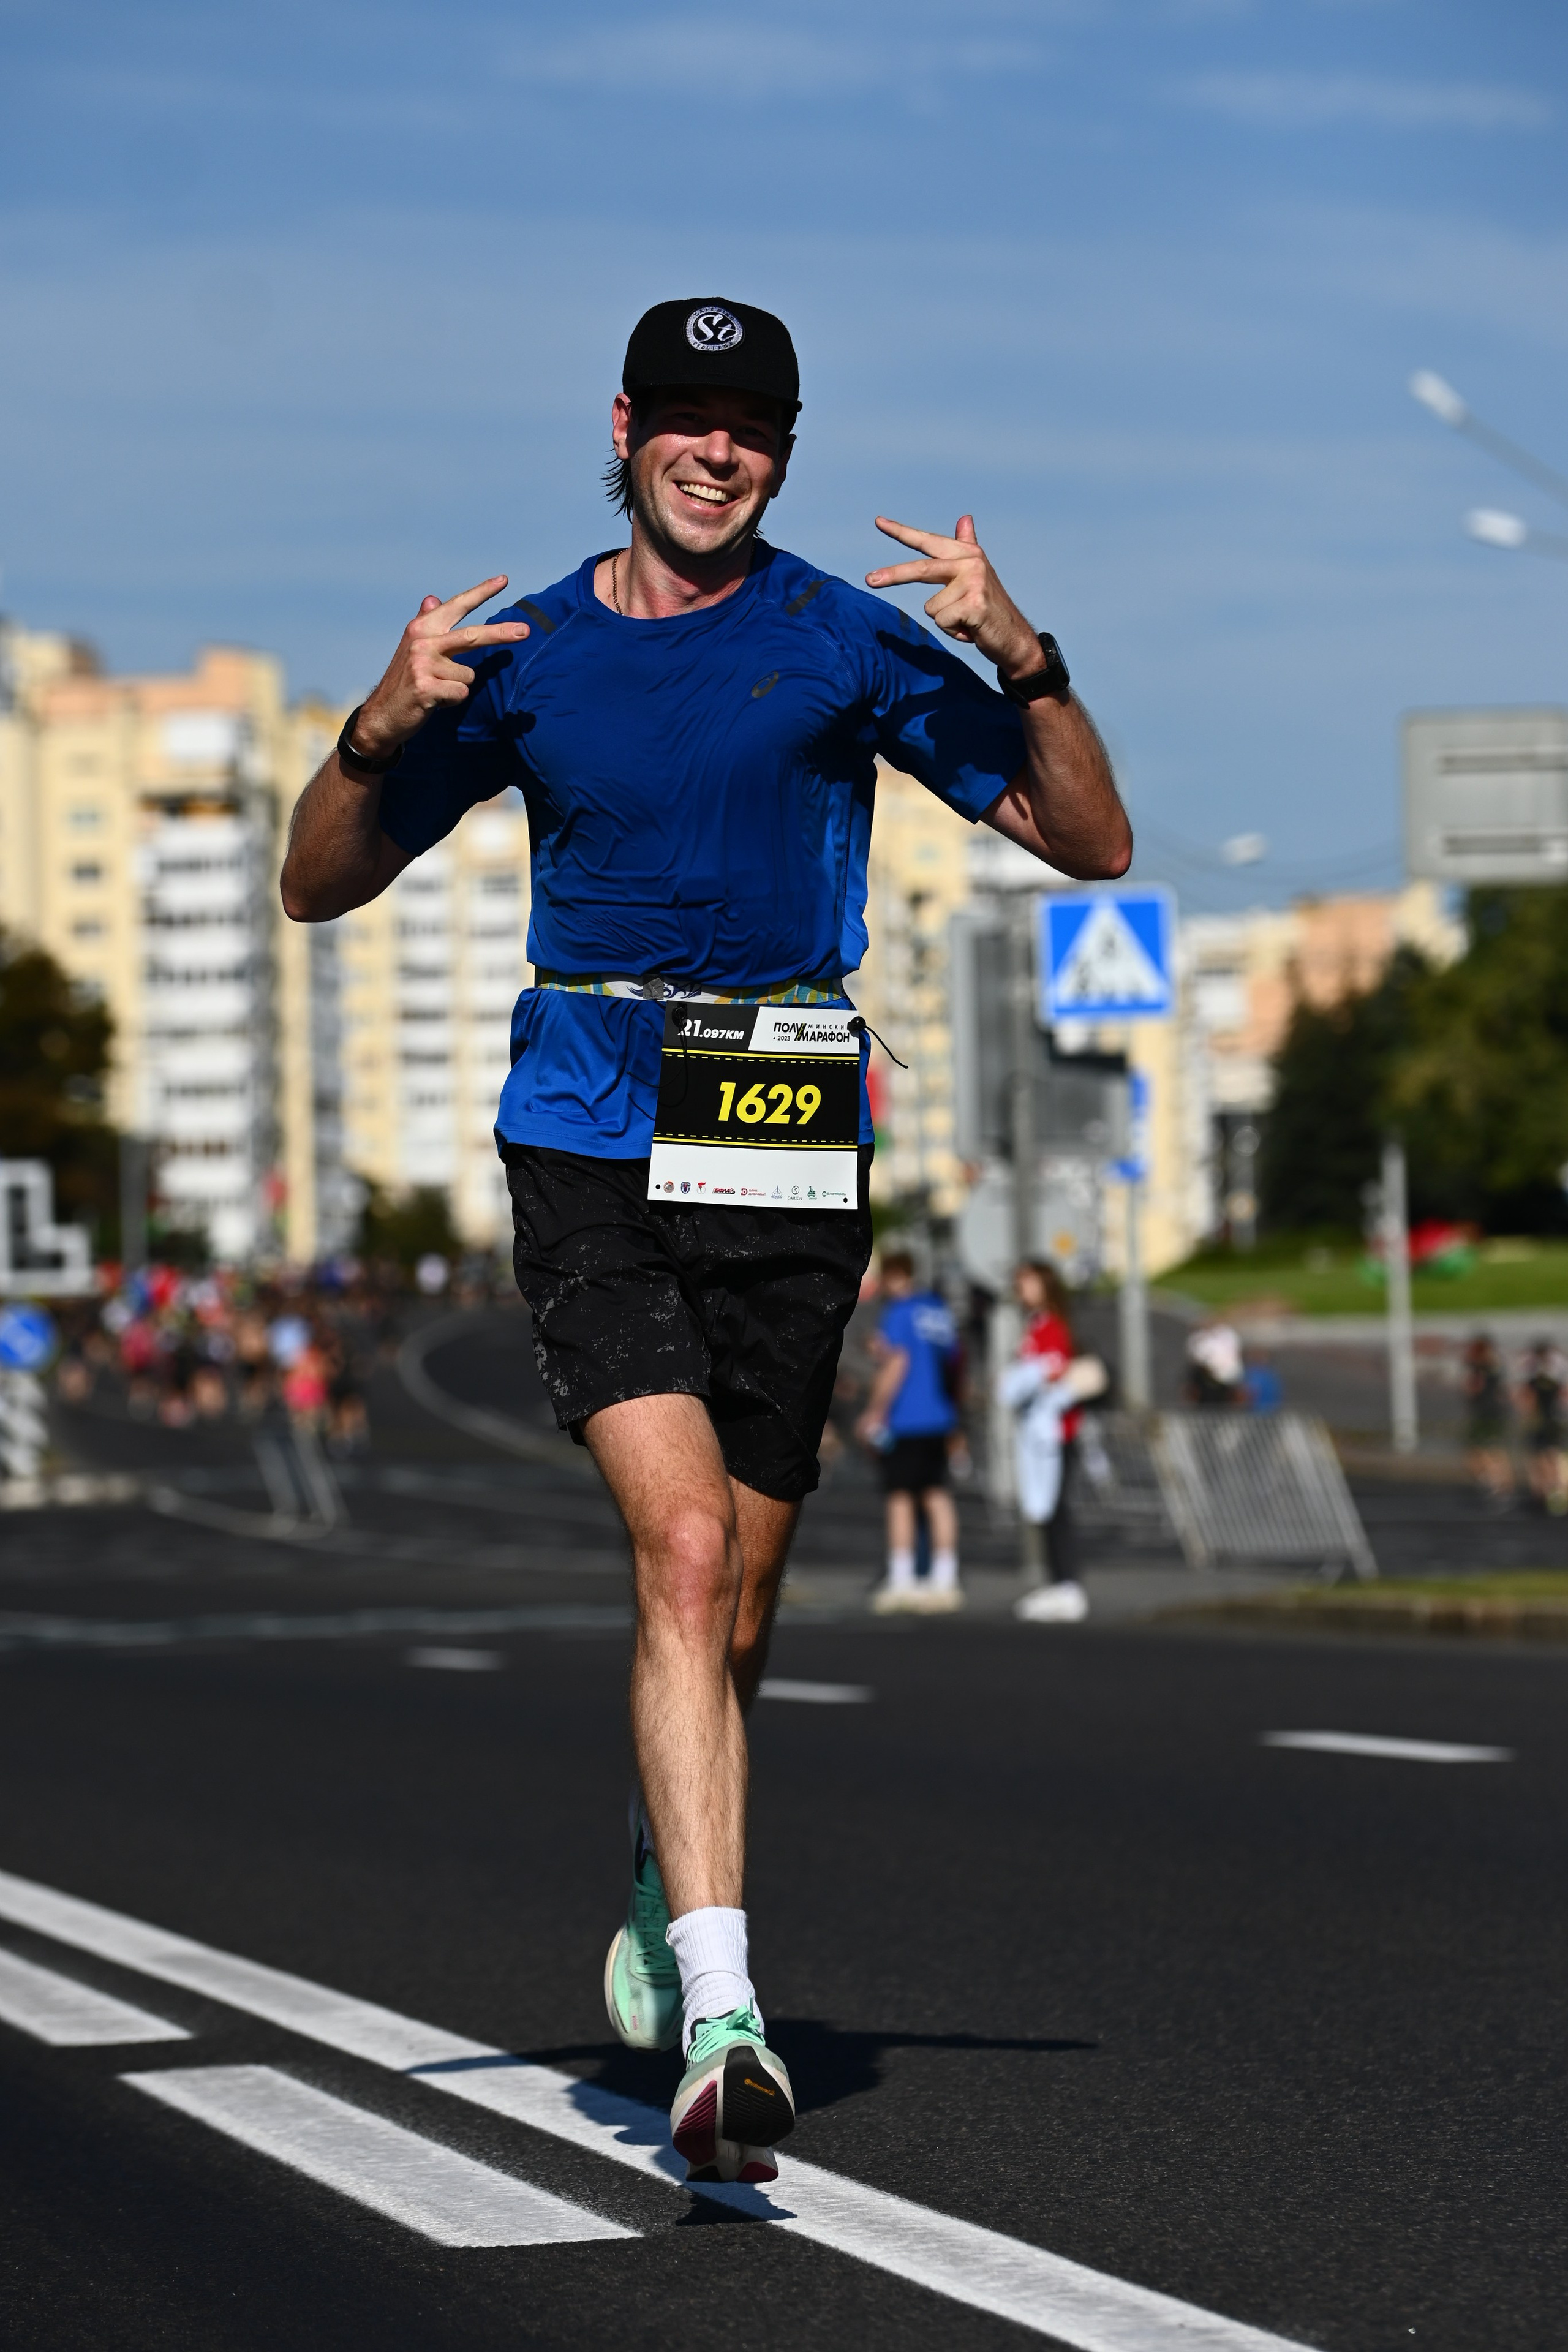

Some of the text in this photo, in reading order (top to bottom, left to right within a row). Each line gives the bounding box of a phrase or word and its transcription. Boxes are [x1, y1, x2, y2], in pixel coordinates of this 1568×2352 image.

[773, 1022, 807, 1035] ПОЛУ
[797, 1031, 850, 1042] МАРАФОН
[718, 1081, 821, 1125] 1629
